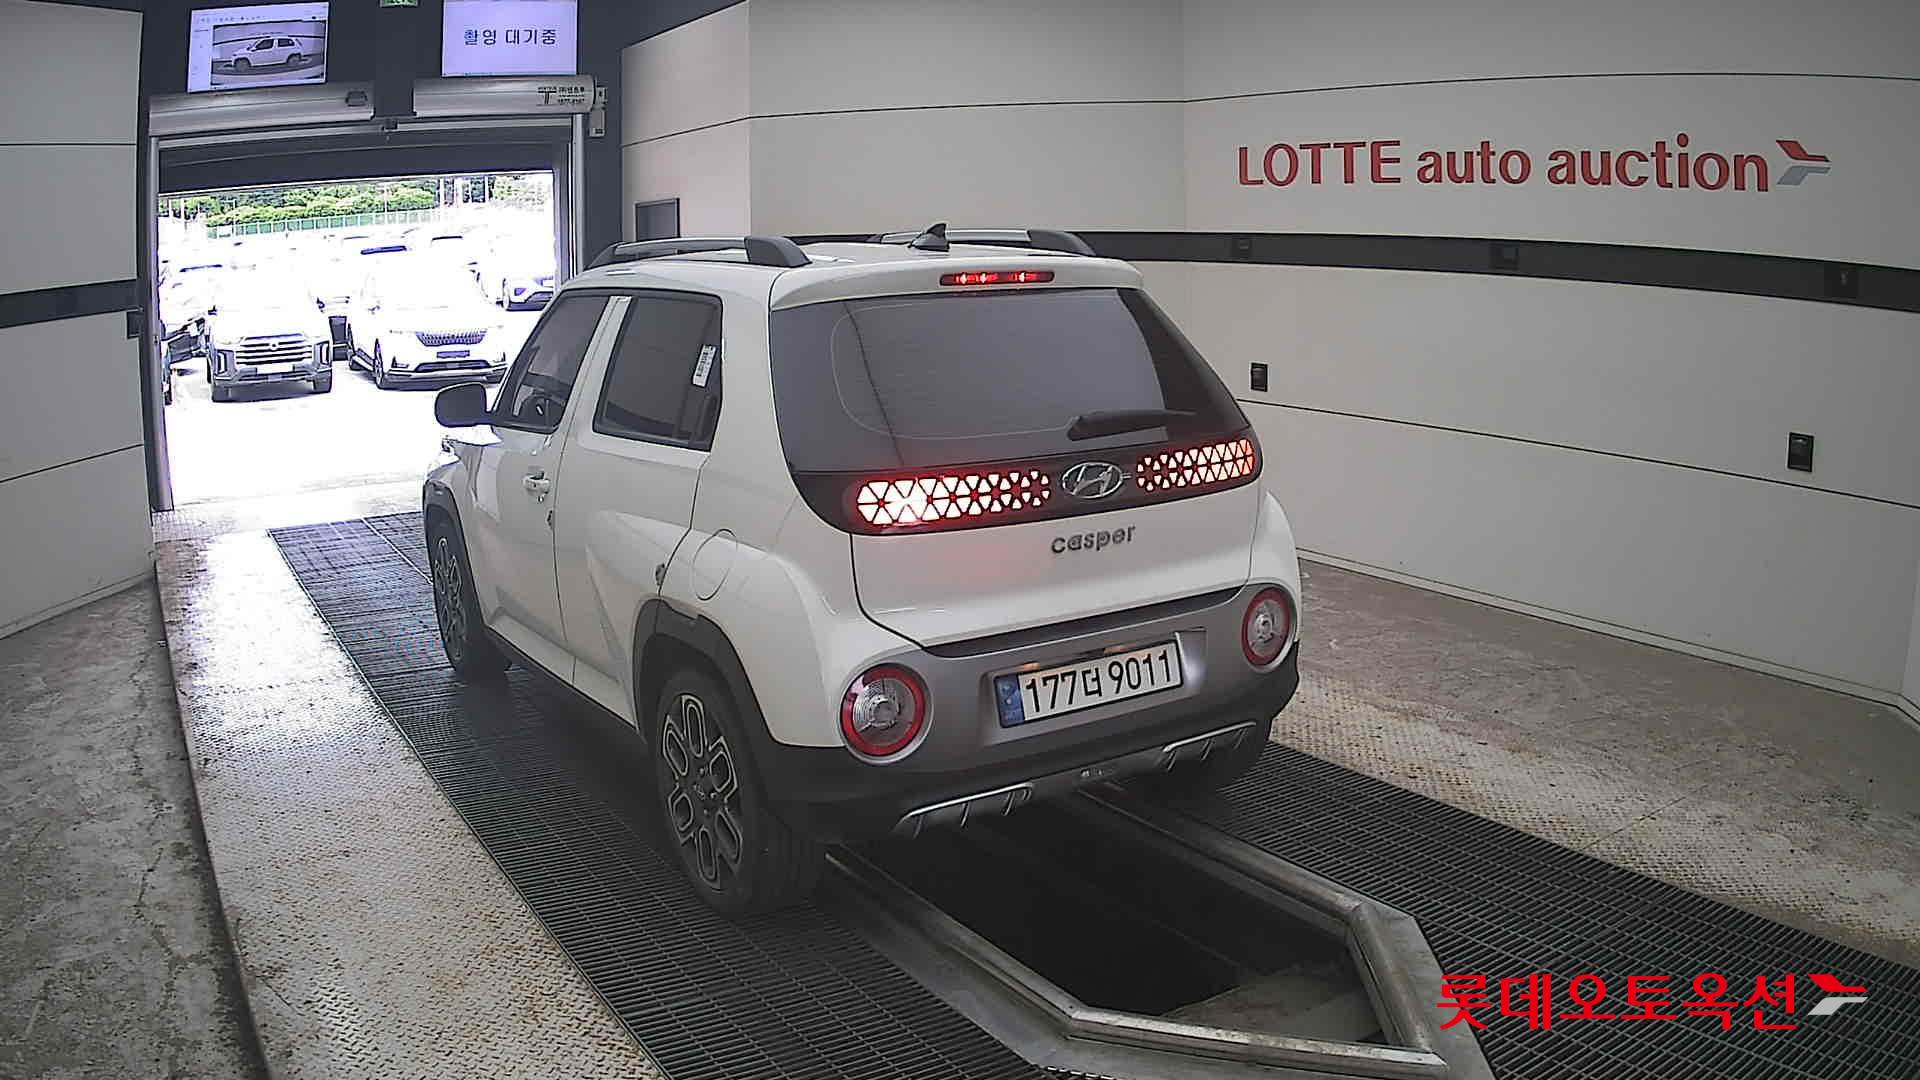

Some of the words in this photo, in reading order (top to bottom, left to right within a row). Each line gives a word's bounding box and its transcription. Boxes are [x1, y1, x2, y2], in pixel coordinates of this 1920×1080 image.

[505, 29, 557, 45] 대기중
[1238, 140, 1401, 187] LOTTE
[1416, 140, 1532, 185] auto
[1546, 132, 1769, 193] auction
[1050, 525, 1137, 555] casper
[1025, 667, 1103, 713] 177더
[1108, 649, 1172, 695] 9011
